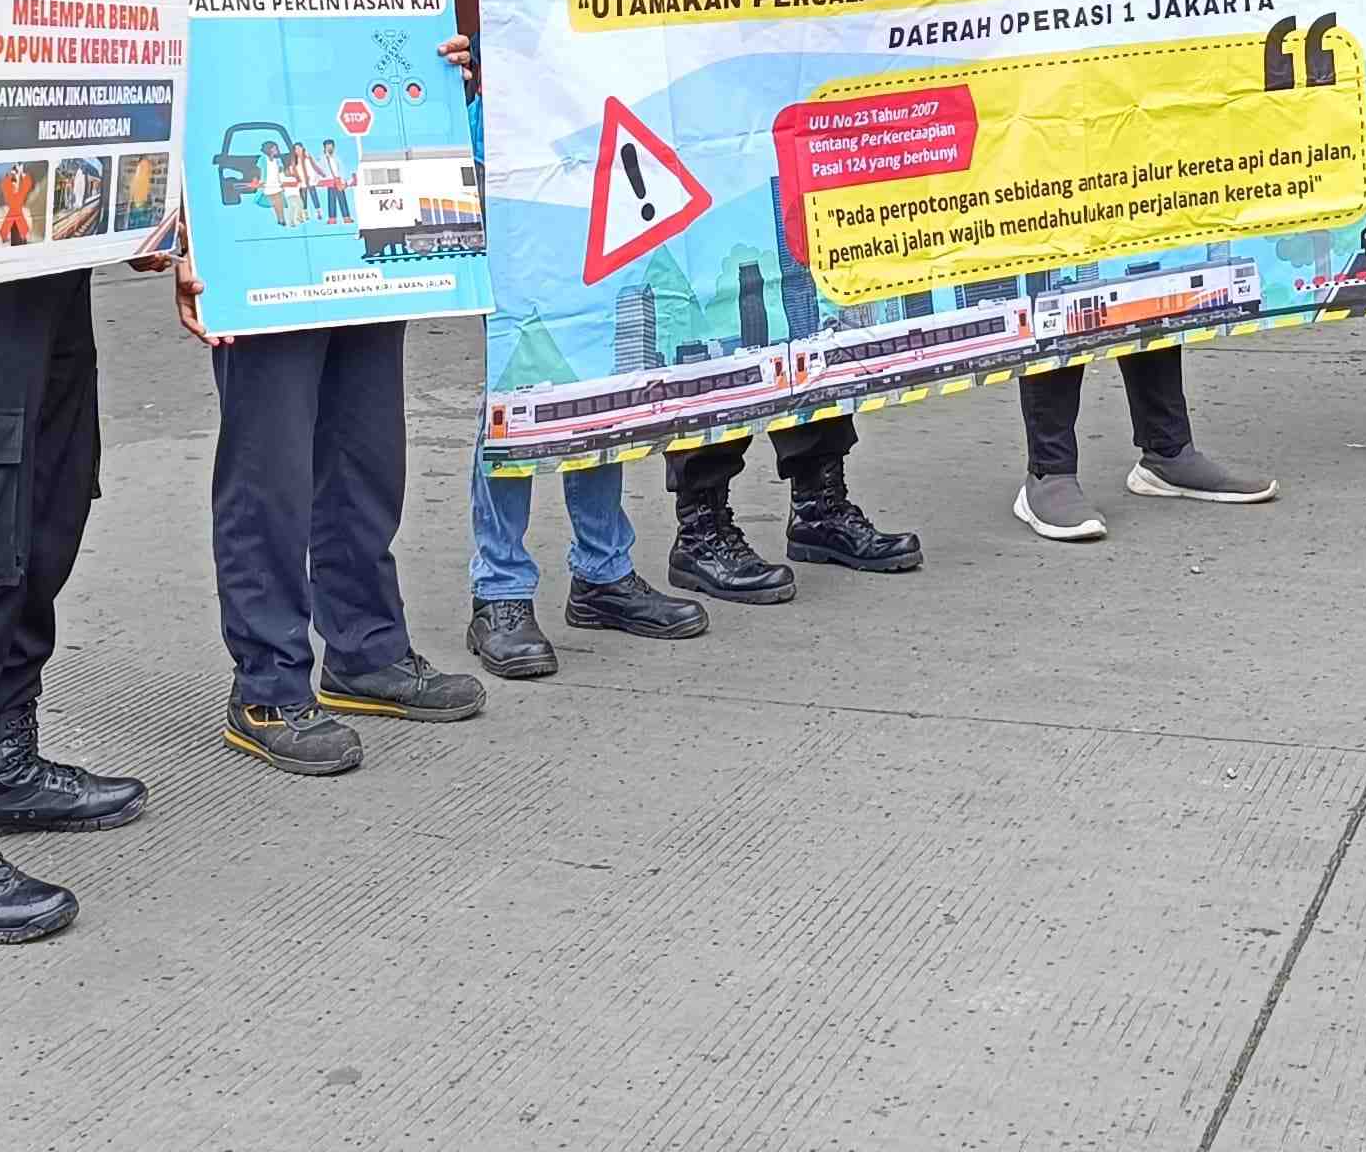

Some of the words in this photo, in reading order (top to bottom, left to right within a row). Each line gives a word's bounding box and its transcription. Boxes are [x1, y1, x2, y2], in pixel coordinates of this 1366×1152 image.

[107, 3, 160, 32] BENDA
[888, 19, 992, 49] DAERAH
[1000, 3, 1113, 35] OPERASI
[1122, 2, 1135, 23] 1
[57, 36, 77, 64] KE
[80, 38, 138, 65] KERETA
[141, 39, 165, 65] API
[64, 86, 89, 106] JIKA
[89, 85, 143, 106] KELUARGA
[143, 85, 172, 105] ANDA
[38, 118, 87, 140] MENJADI
[87, 117, 131, 139] KORBAN
[344, 111, 368, 123] STOP
[809, 114, 829, 131] UU
[832, 112, 852, 129] No
[853, 110, 869, 127] 23
[870, 107, 908, 125] Tahun
[911, 101, 939, 119] 2007
[809, 132, 857, 156] tentang
[861, 121, 956, 150] Perkeretaapian
[812, 159, 842, 178] Pasal
[845, 157, 866, 174] 124
[868, 152, 901, 175] yang
[903, 144, 958, 169] berbunyi
[827, 206, 876, 229] "Pada
[879, 191, 990, 224] perpotongan
[995, 176, 1073, 205] sebidang
[1078, 170, 1129, 190] antara
[1131, 162, 1175, 188] jalur
[1178, 154, 1234, 178] kereta
[1238, 151, 1265, 176] api
[1268, 146, 1302, 168] dan
[1305, 142, 1357, 170] jalan,
[829, 239, 899, 269] pemakai
[902, 229, 945, 257] jalan
[950, 221, 995, 248] wajib
[999, 202, 1124, 237] mendahulukan
[1129, 189, 1221, 219] perjalanan
[1225, 182, 1282, 203] kereta
[1287, 175, 1323, 202] api"
